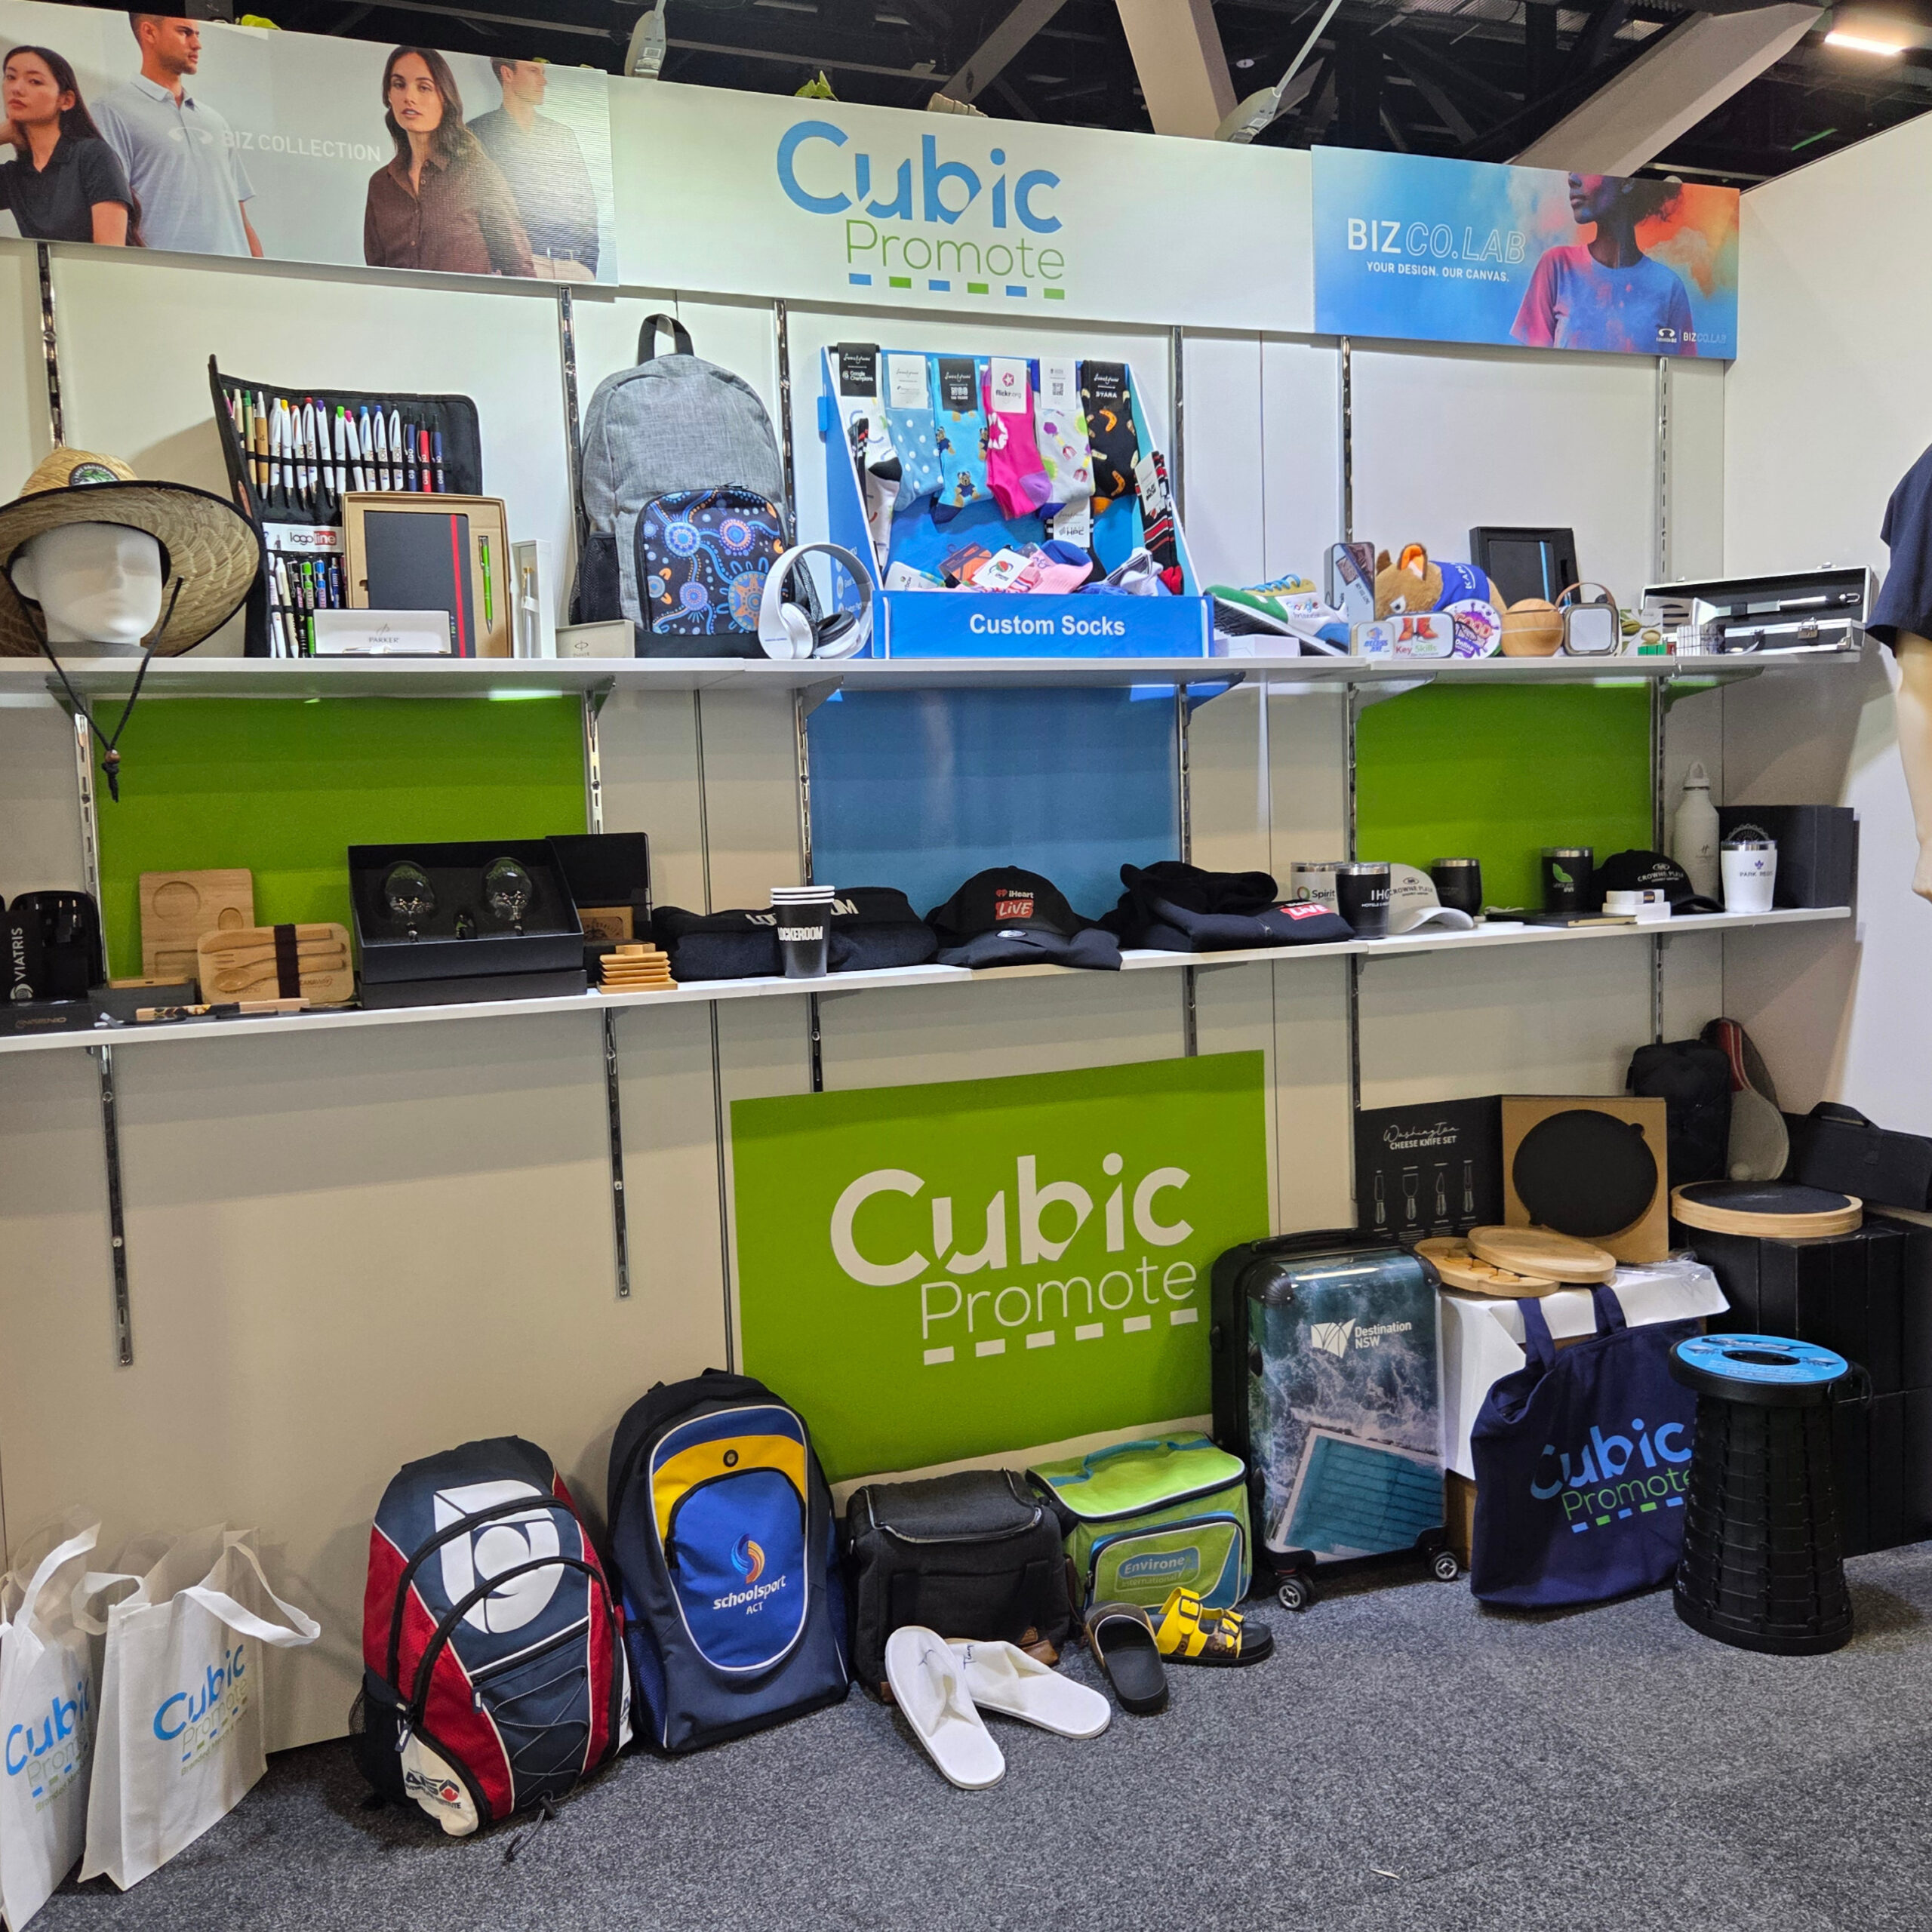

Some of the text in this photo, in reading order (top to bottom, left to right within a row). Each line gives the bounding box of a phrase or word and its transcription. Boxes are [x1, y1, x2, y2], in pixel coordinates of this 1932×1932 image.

[220, 126, 381, 162] BIZ COLLECTION
[777, 120, 1063, 234] Cubic
[846, 219, 1066, 280] Promote
[1366, 260, 1510, 283] YOUR DESIGN. OUR CANVAS.
[970, 614, 1126, 636] Custom Socks
[368, 636, 399, 645] PARKER
[1396, 646, 1412, 655] Key
[1415, 644, 1438, 653] Skills
[1008, 890, 1034, 900] iHeart
[1312, 890, 1335, 899] Spirit
[11, 928, 26, 982] VIATRIS
[1383, 1121, 1462, 1143] Washington
[1389, 1135, 1457, 1150] CHEESE KNIFE SET
[830, 1152, 1195, 1287] Cubic
[921, 1256, 1198, 1340] Promote
[1355, 1321, 1412, 1338] Destination
[1355, 1335, 1380, 1349] NSW
[1530, 1418, 1693, 1500] Cubic
[712, 1574, 786, 1611] schoolsport
[746, 1601, 764, 1615] ACT
[153, 1644, 246, 1740] Cubic
[6, 1677, 90, 1776] Cubic
